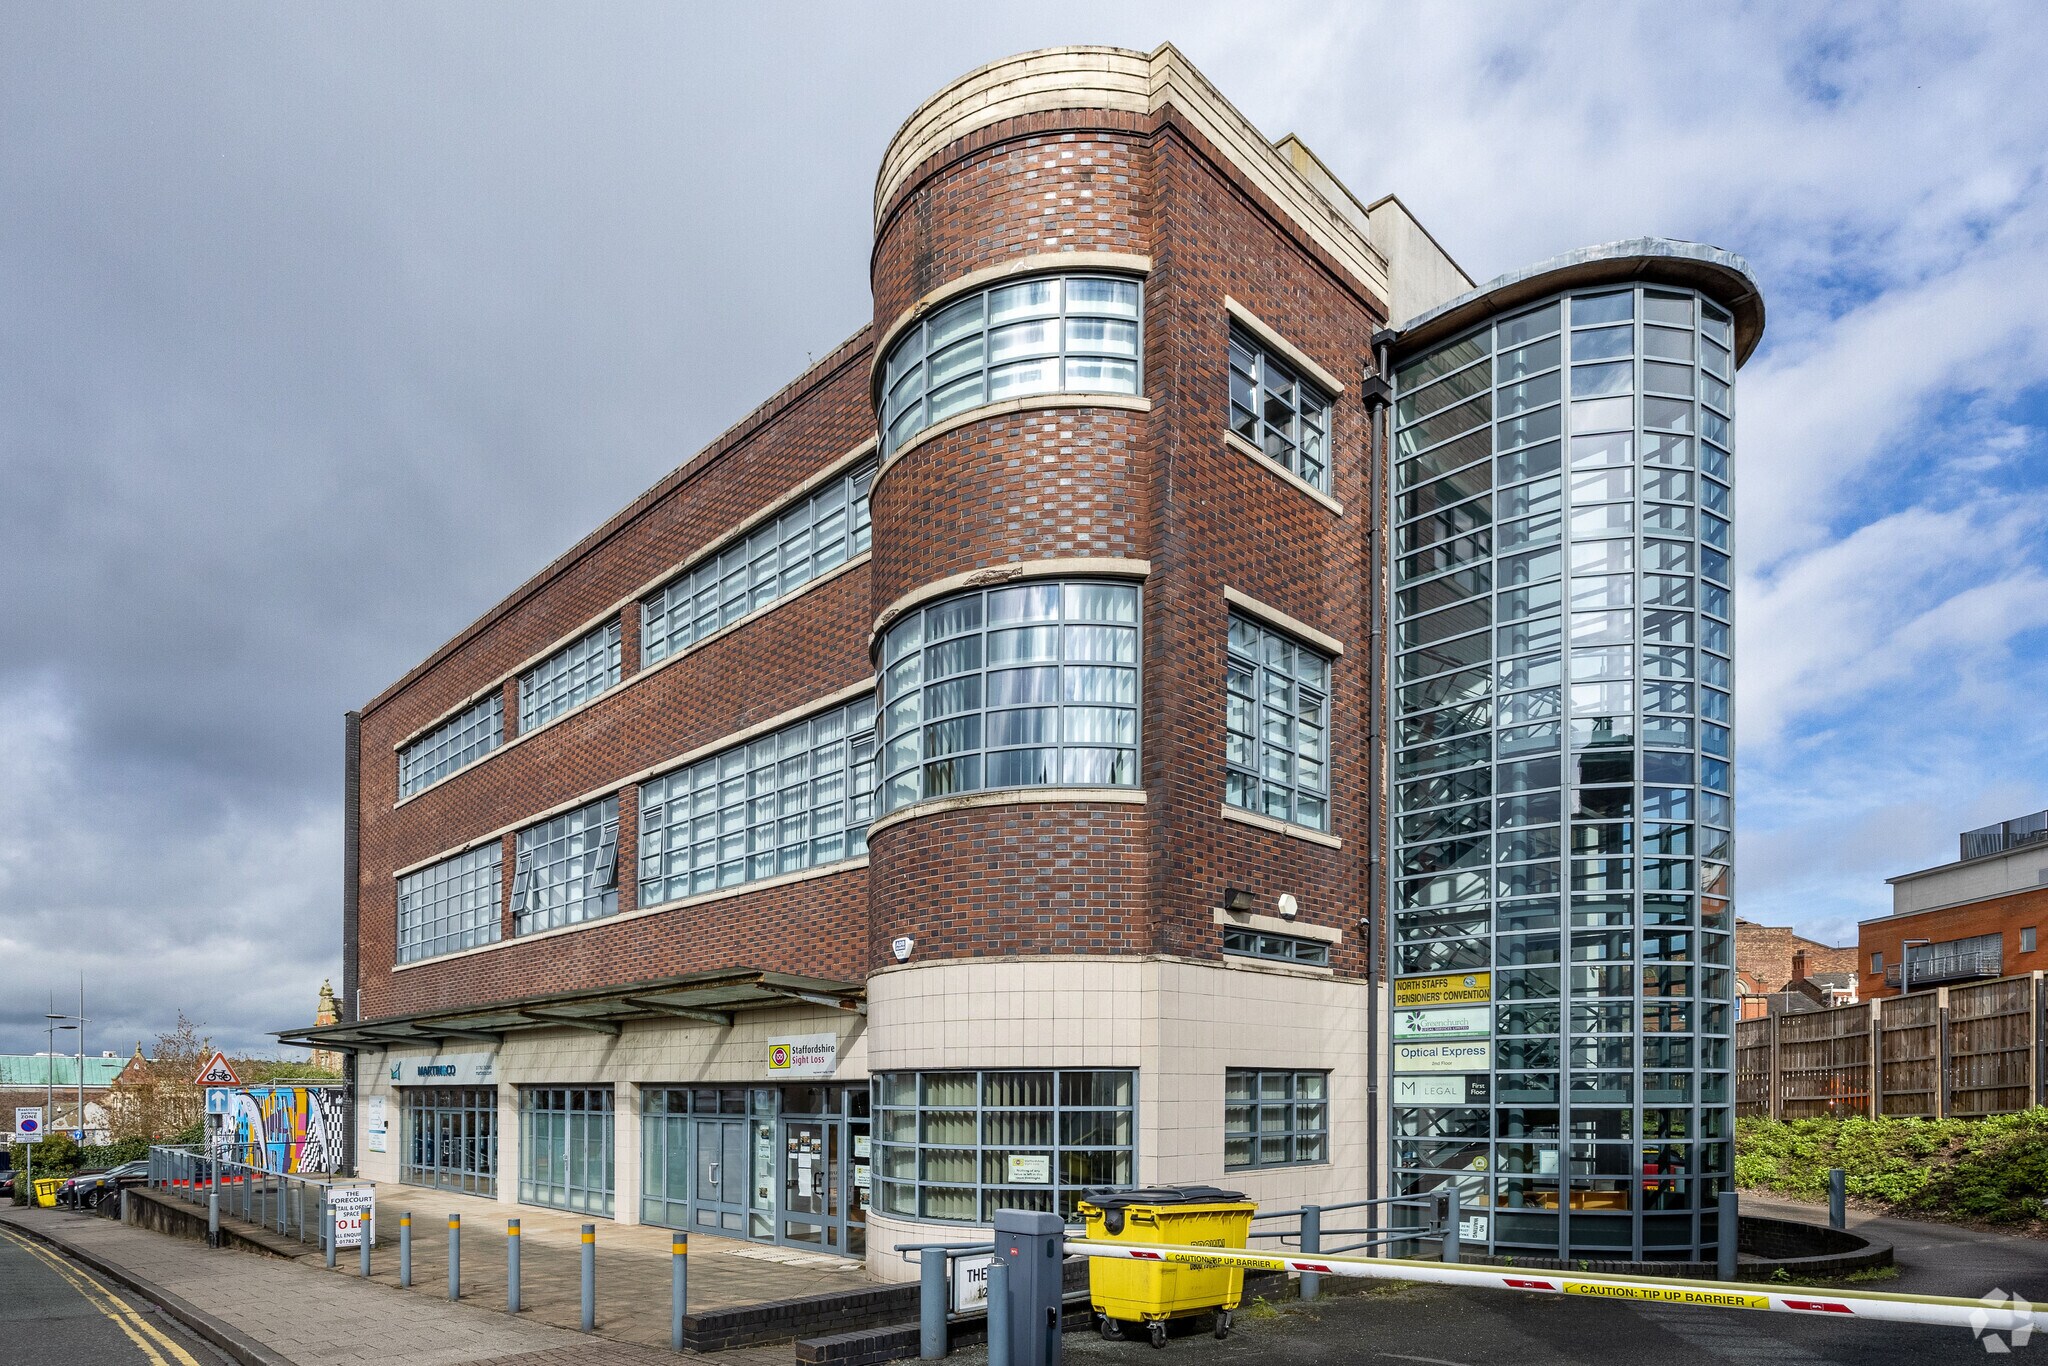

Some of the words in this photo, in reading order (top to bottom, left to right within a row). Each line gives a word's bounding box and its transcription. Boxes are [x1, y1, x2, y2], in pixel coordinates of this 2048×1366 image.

[1397, 981, 1420, 991] NORTH
[1421, 979, 1448, 989] STAFFS
[1443, 989, 1490, 1001] CONVENTION
[1420, 1017, 1469, 1027] Greenchurch
[792, 1044, 835, 1054] Staffordshire
[1401, 1047, 1438, 1059] Optical
[1442, 1046, 1486, 1058] Express
[792, 1055, 808, 1066] Sight
[1401, 1081, 1416, 1096] M
[1424, 1087, 1457, 1095] LEGAL
[1236, 1259, 1271, 1268] BARRIER
[967, 1267, 987, 1282] THE
[1580, 1285, 1638, 1298] CAUTION:
[1641, 1289, 1661, 1299] TIP
[1664, 1291, 1682, 1300] UP
[1685, 1292, 1745, 1306] BARRIER
